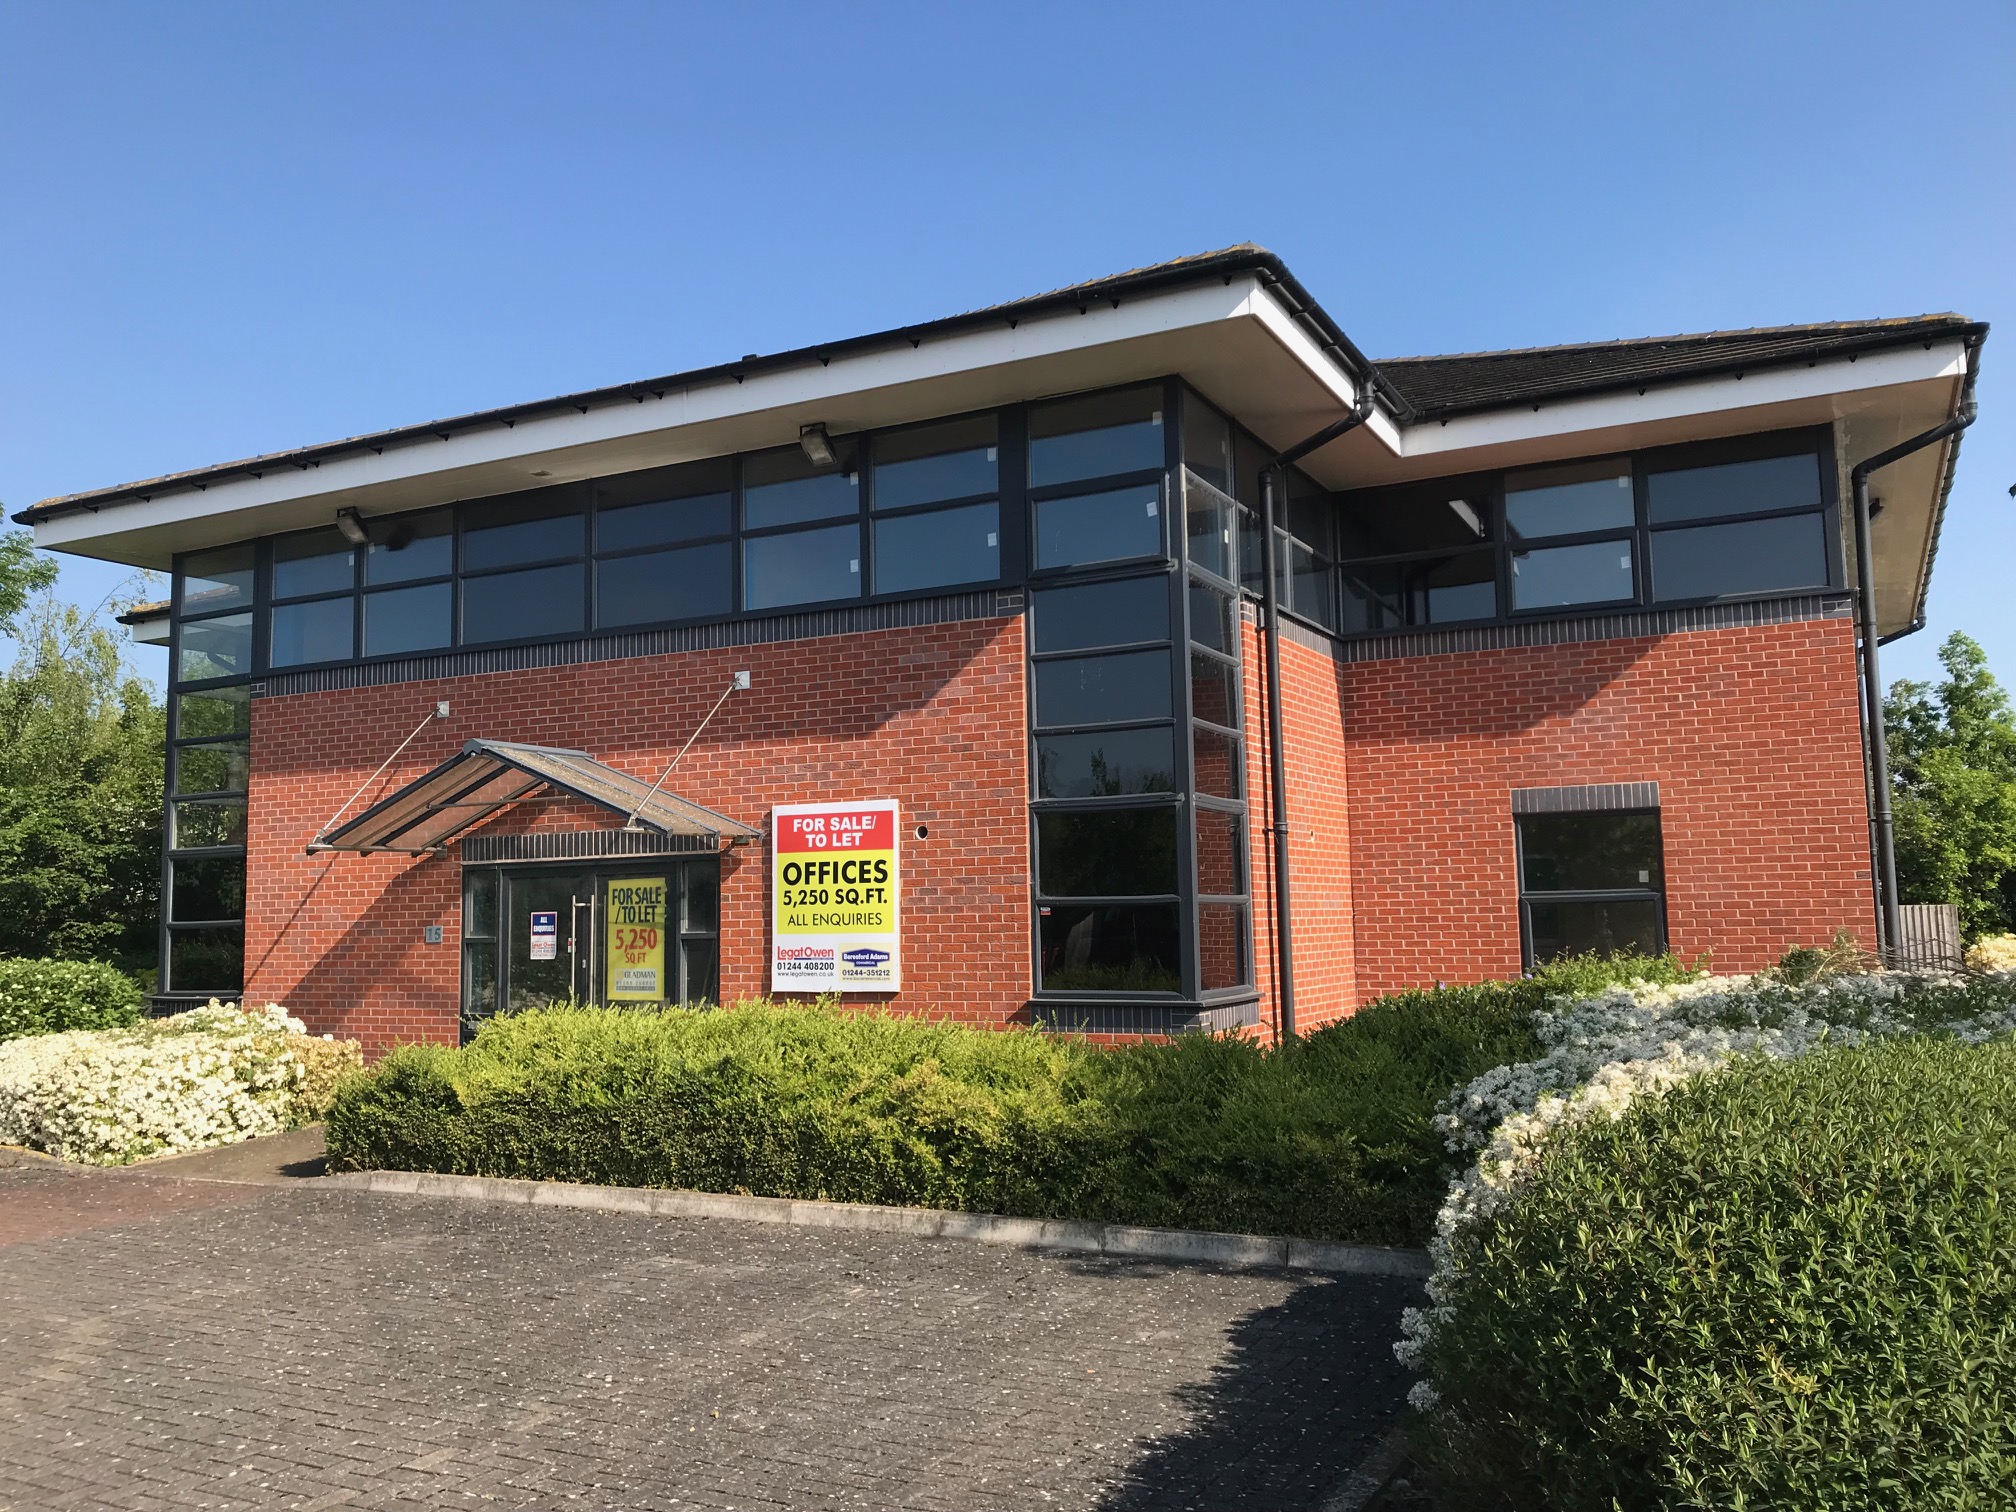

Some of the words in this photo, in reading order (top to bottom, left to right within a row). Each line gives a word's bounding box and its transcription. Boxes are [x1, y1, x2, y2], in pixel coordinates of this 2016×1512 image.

[793, 818, 825, 832] FOR
[830, 815, 877, 831] SALE/
[805, 834, 827, 848] TO
[832, 832, 863, 847] LET
[782, 859, 888, 886] OFFICES
[612, 888, 634, 905] FOR
[635, 886, 661, 905] SALE
[783, 889, 829, 908] 5,250
[834, 888, 888, 906] SQ.FT.
[638, 905, 657, 923] LET
[787, 914, 808, 926] ALL
[812, 912, 882, 927] ENQUIRIES
[427, 928, 441, 941] 15
[615, 928, 657, 953] 5,250
[625, 952, 636, 965] SQ
[637, 952, 647, 964] FT
[777, 962, 802, 970] 01244
[804, 962, 835, 971] 408200
